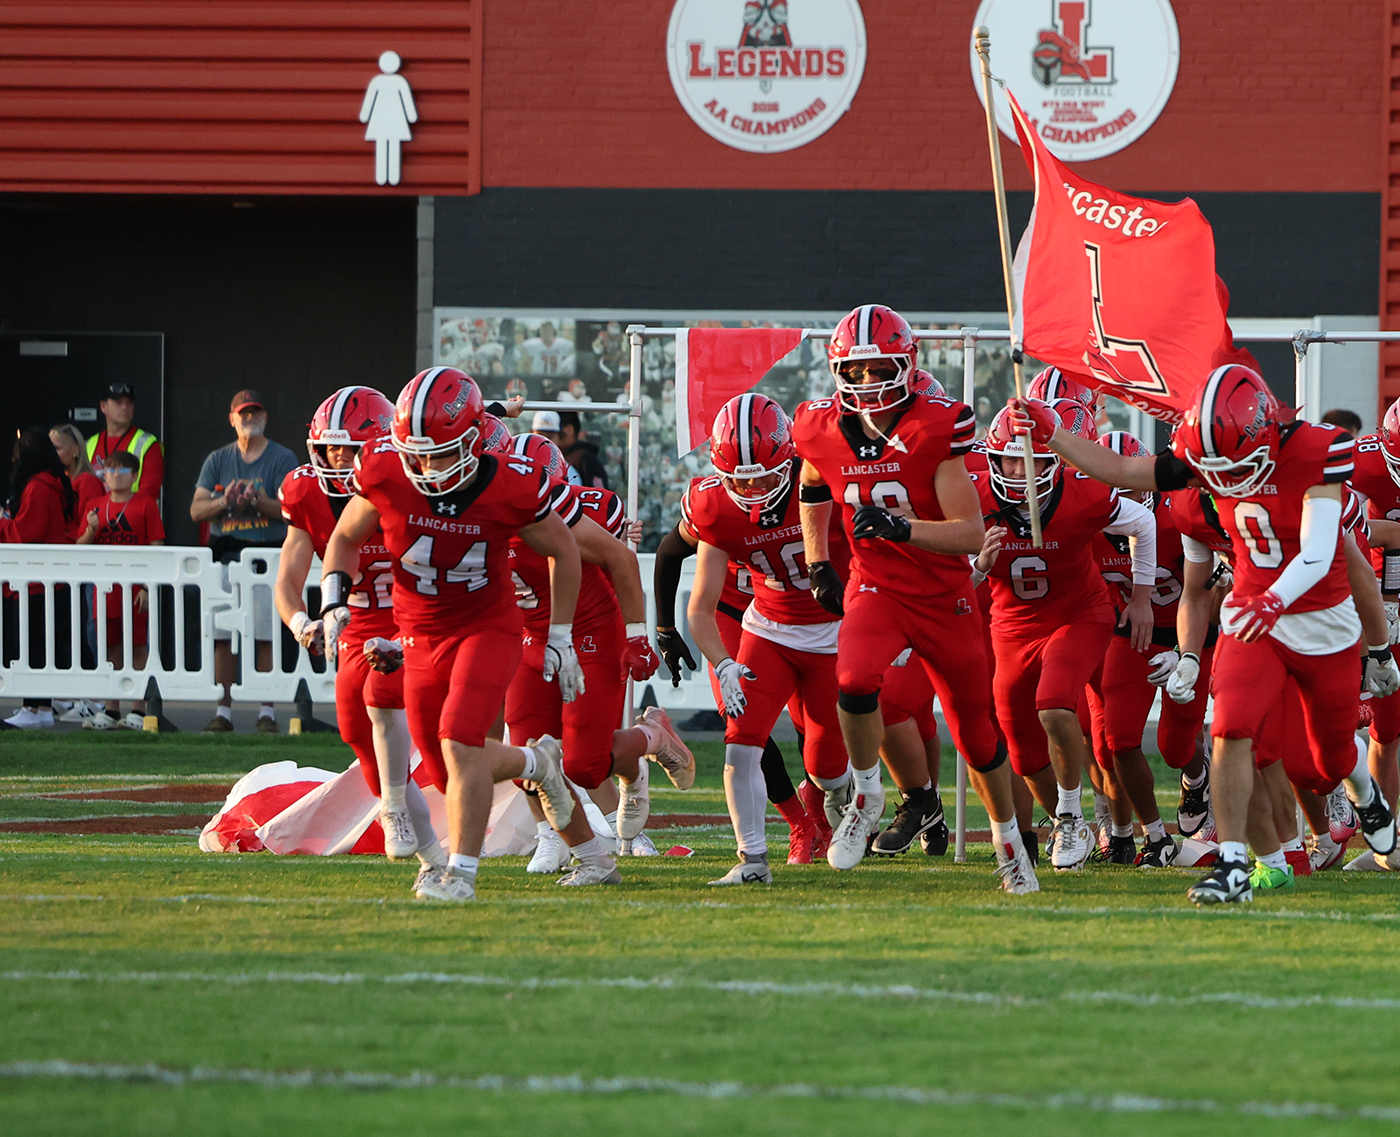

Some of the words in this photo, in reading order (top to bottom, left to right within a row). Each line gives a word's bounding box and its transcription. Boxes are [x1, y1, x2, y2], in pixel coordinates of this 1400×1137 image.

[688, 41, 847, 79] LEGENDS
[1053, 86, 1114, 98] FOOTBALL
[703, 99, 729, 124] AA
[729, 97, 828, 136] CHAMPIONS
[1040, 107, 1138, 144] CHAMPIONS
[852, 347, 877, 355] Riddell
[807, 397, 834, 411] 8
[1070, 406, 1086, 436] egends
[1243, 390, 1268, 442] Legends
[322, 431, 348, 440] Riddell
[486, 422, 507, 452] egends
[1356, 435, 1381, 453] 38
[1006, 445, 1024, 453] Ridde
[507, 453, 535, 477] 44
[736, 467, 762, 475] Riddell
[841, 462, 901, 476] LANCASTER
[1222, 478, 1278, 496] LANSTER
[579, 488, 604, 511] 13
[408, 514, 481, 535] LANCASTER
[1233, 501, 1284, 568] 0
[1000, 541, 1059, 551] LANCATER
[400, 533, 489, 596] 44
[750, 540, 812, 592] 10
[1102, 557, 1133, 567] LANCA
[1009, 555, 1050, 601] 6
